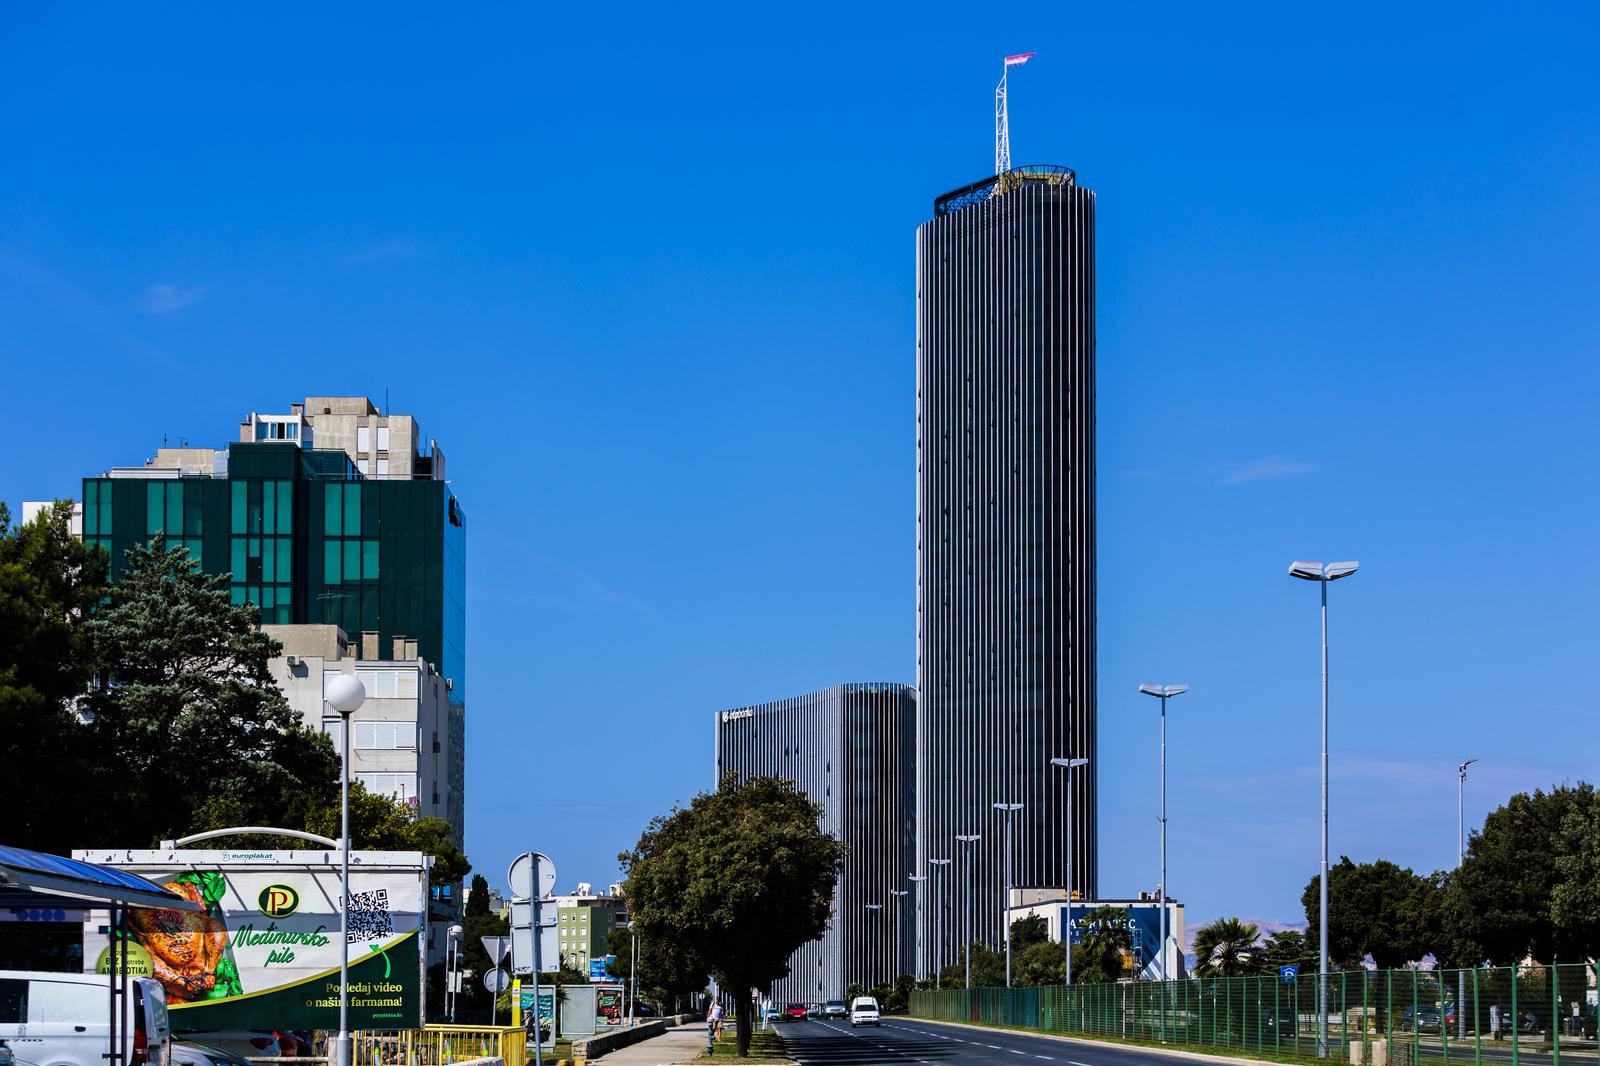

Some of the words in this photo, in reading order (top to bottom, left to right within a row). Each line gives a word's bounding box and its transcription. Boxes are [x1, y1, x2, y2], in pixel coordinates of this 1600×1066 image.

[105, 957, 120, 965] BZ
[264, 947, 295, 968] pile
[101, 966, 148, 974] ANIBOTIKA
[373, 982, 403, 993] video
[305, 1000, 313, 1008] o
[351, 996, 403, 1008] farmama!
